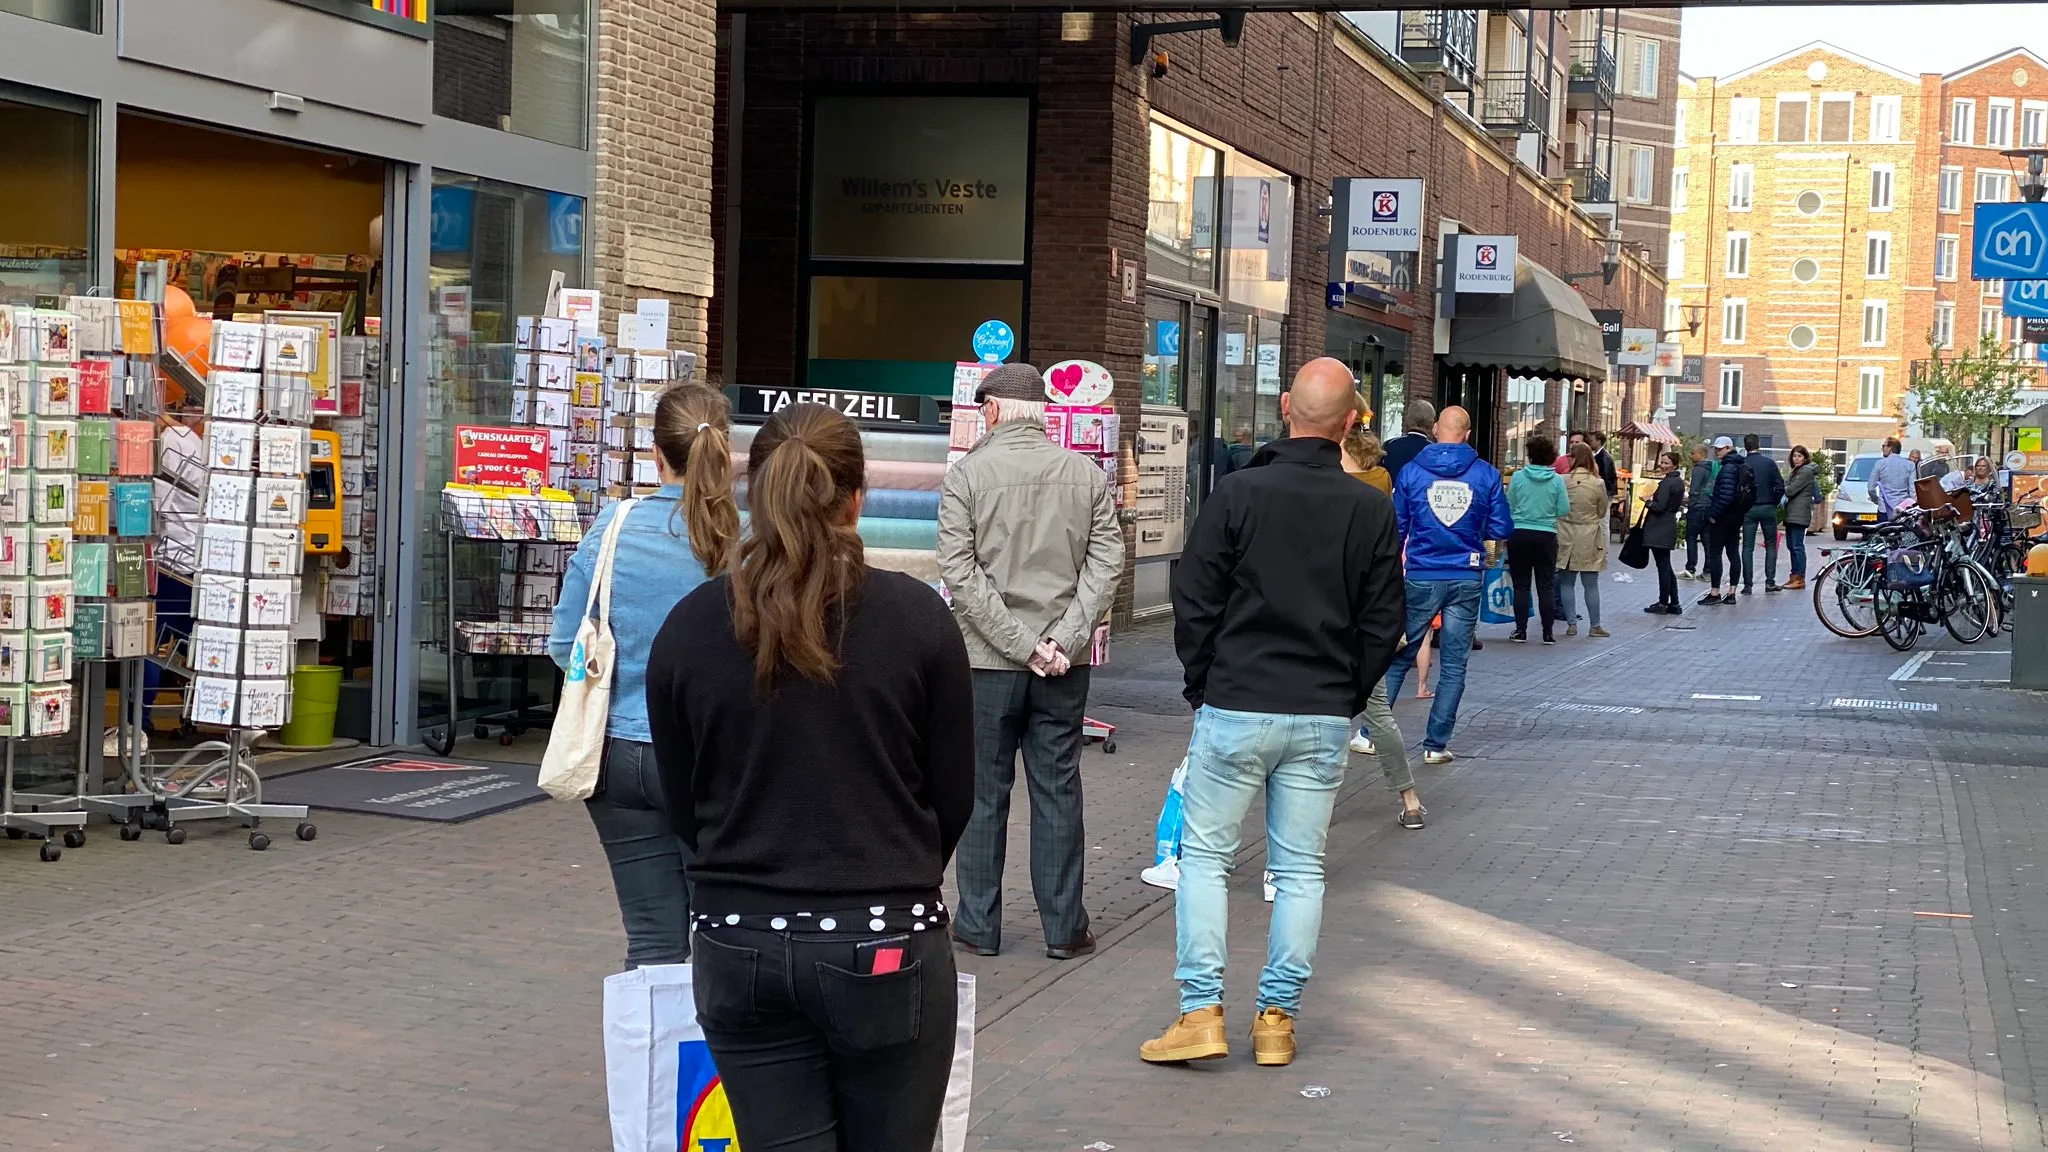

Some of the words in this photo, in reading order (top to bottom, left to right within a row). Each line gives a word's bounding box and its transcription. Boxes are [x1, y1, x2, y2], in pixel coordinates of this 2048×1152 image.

[842, 177, 928, 198] Willem's
[935, 178, 998, 199] Veste
[861, 203, 964, 214] APPARTEMENTEN
[1352, 226, 1418, 237] RODENBURG
[1127, 272, 1133, 291] B
[1459, 272, 1513, 282] RODENBURG
[1603, 322, 1620, 332] Gall
[470, 432, 536, 443] WENSKAARTEN
[477, 464, 482, 472] 5
[1457, 496, 1468, 504] 53
